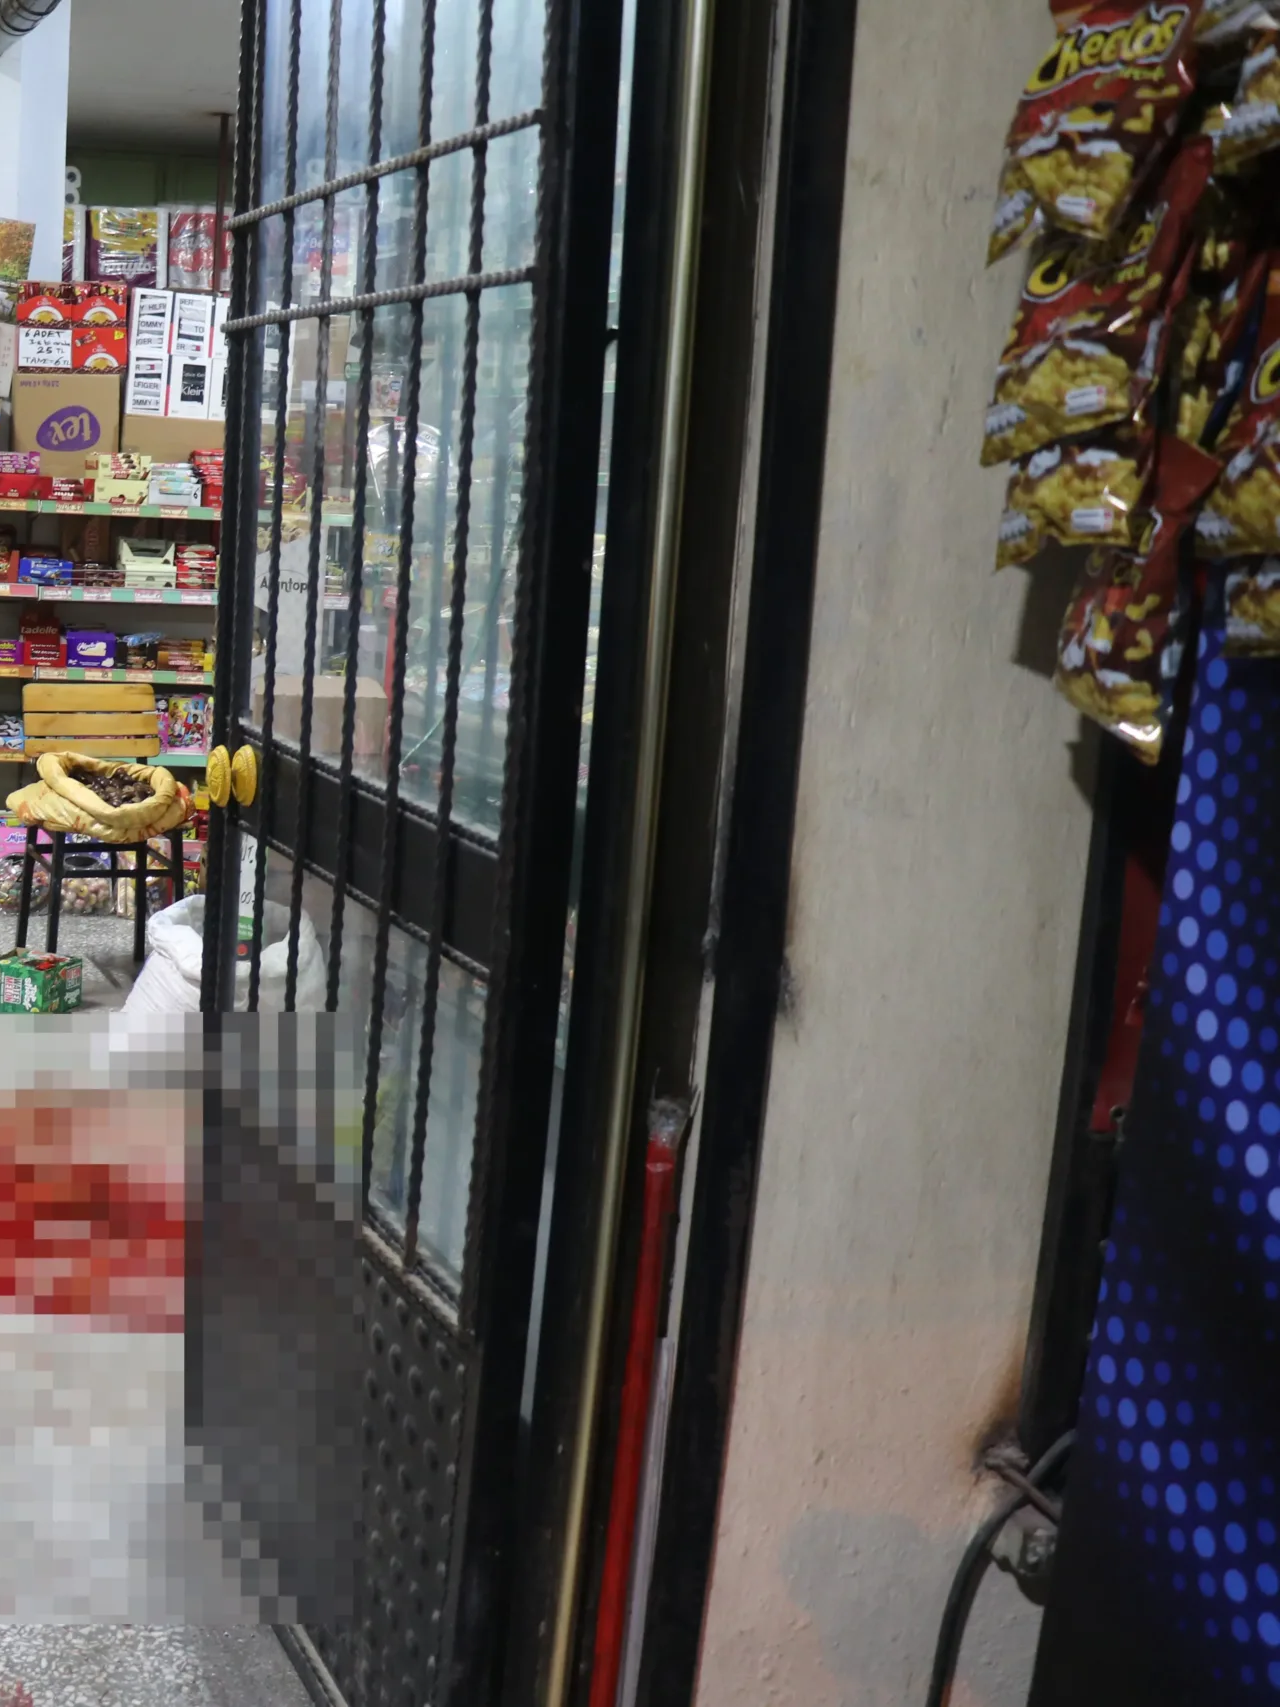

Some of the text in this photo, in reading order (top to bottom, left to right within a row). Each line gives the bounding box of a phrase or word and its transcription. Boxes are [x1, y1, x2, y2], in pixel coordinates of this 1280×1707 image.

[1023, 11, 1182, 94] Cheetos
[34, 329, 65, 338] ADET
[36, 346, 53, 355] 25
[181, 384, 205, 395] Klein
[260, 575, 308, 593] Antop
[5, 976, 13, 1002] MELON
[13, 978, 22, 1004] WATER
